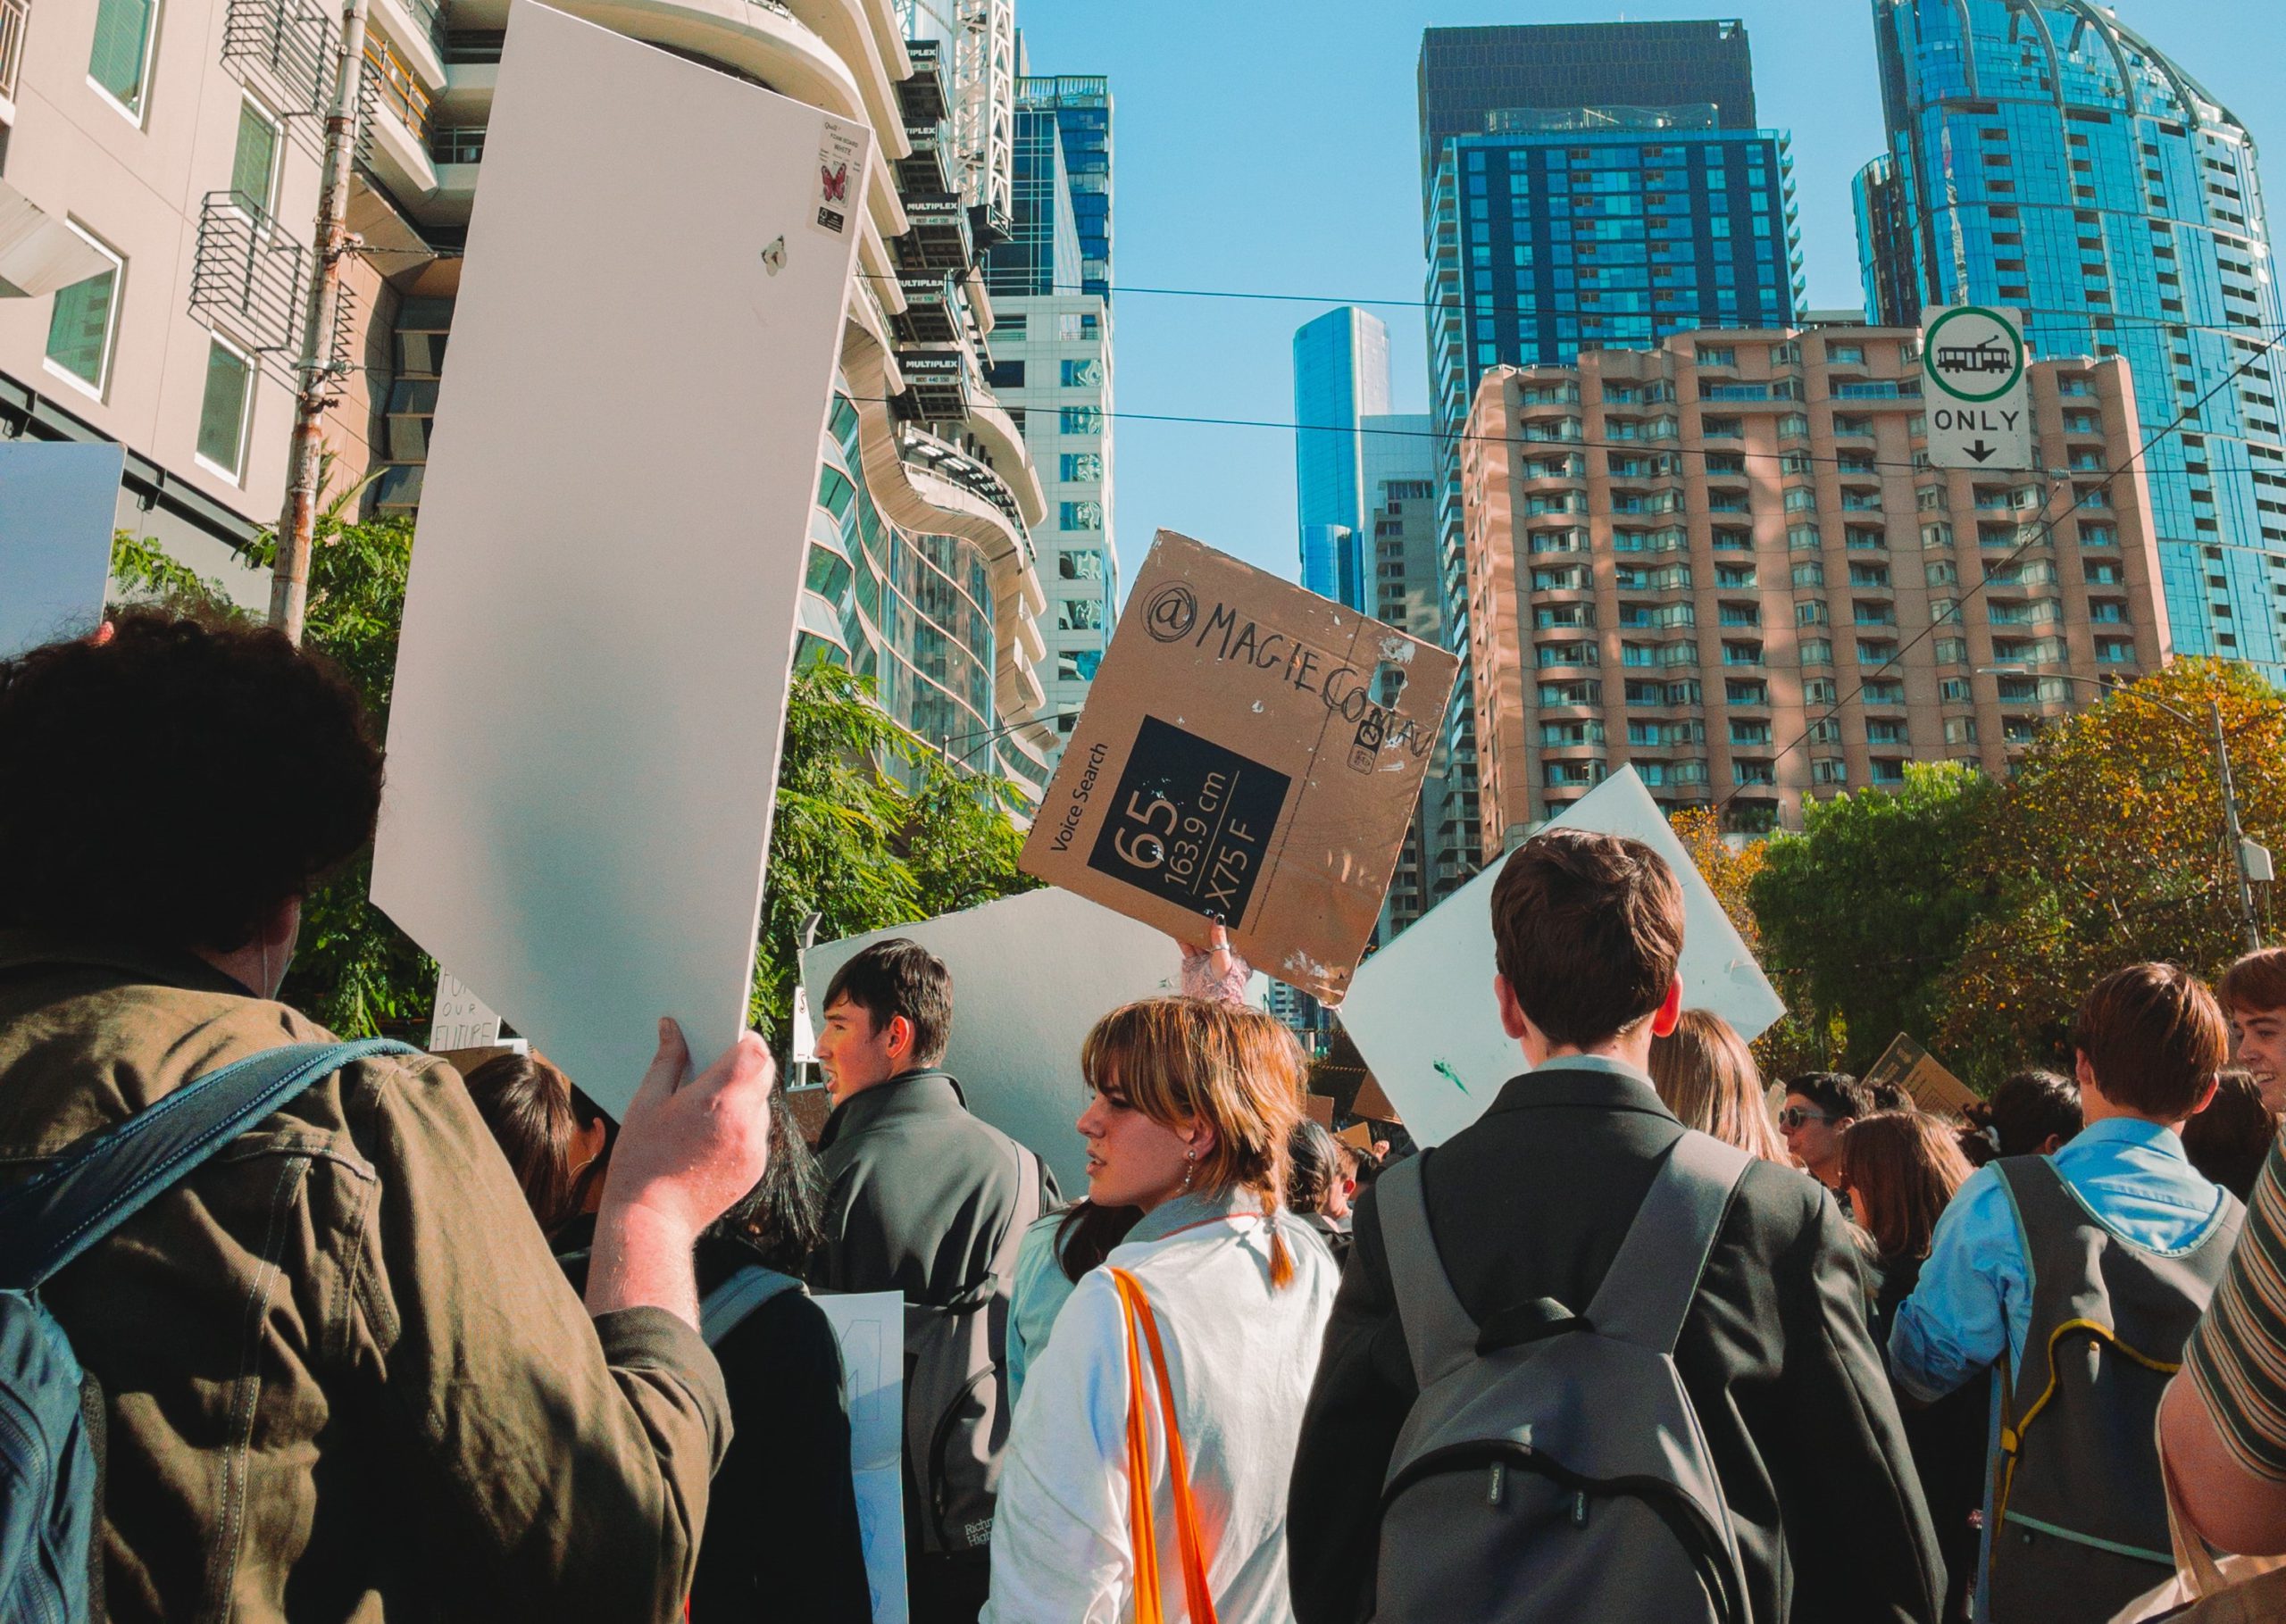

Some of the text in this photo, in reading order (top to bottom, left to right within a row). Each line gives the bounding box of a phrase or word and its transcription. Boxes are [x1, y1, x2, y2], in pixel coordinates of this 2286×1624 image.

[906, 203, 957, 211] MULTIPLEX
[1935, 410, 2019, 430] ONLY
[1050, 742, 1108, 853] Voice Search
[1114, 790, 1178, 870] 65
[1164, 771, 1226, 885] 163.9 cm
[1205, 819, 1255, 910] X75 F
[443, 1002, 476, 1017] OUR
